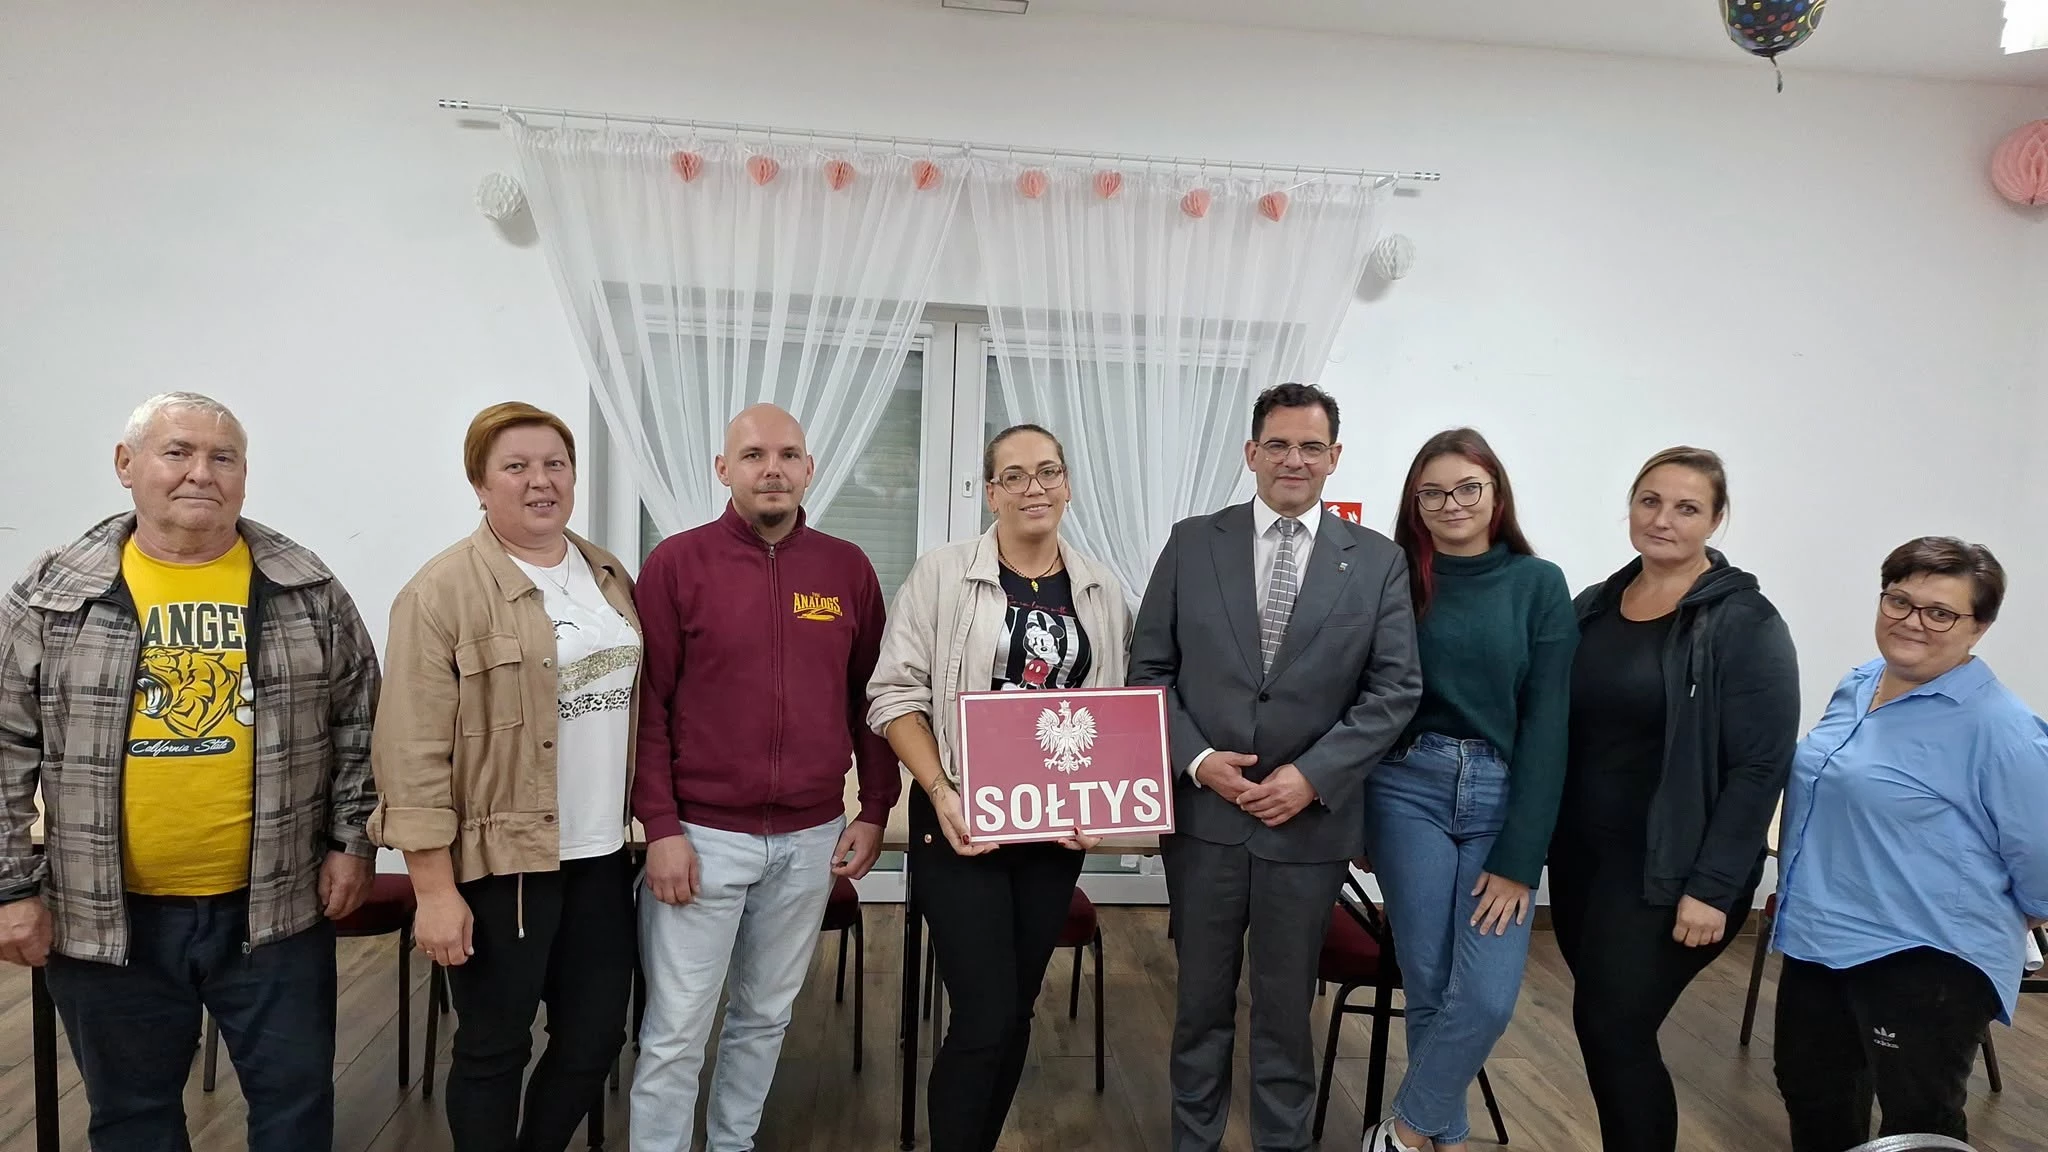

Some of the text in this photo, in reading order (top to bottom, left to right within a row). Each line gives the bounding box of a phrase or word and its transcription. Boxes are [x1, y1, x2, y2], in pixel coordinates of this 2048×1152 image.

[793, 592, 841, 613] ANALOGS
[142, 602, 249, 651] ANGE
[131, 738, 231, 757] California State
[975, 778, 1161, 832] SOŁTYS
